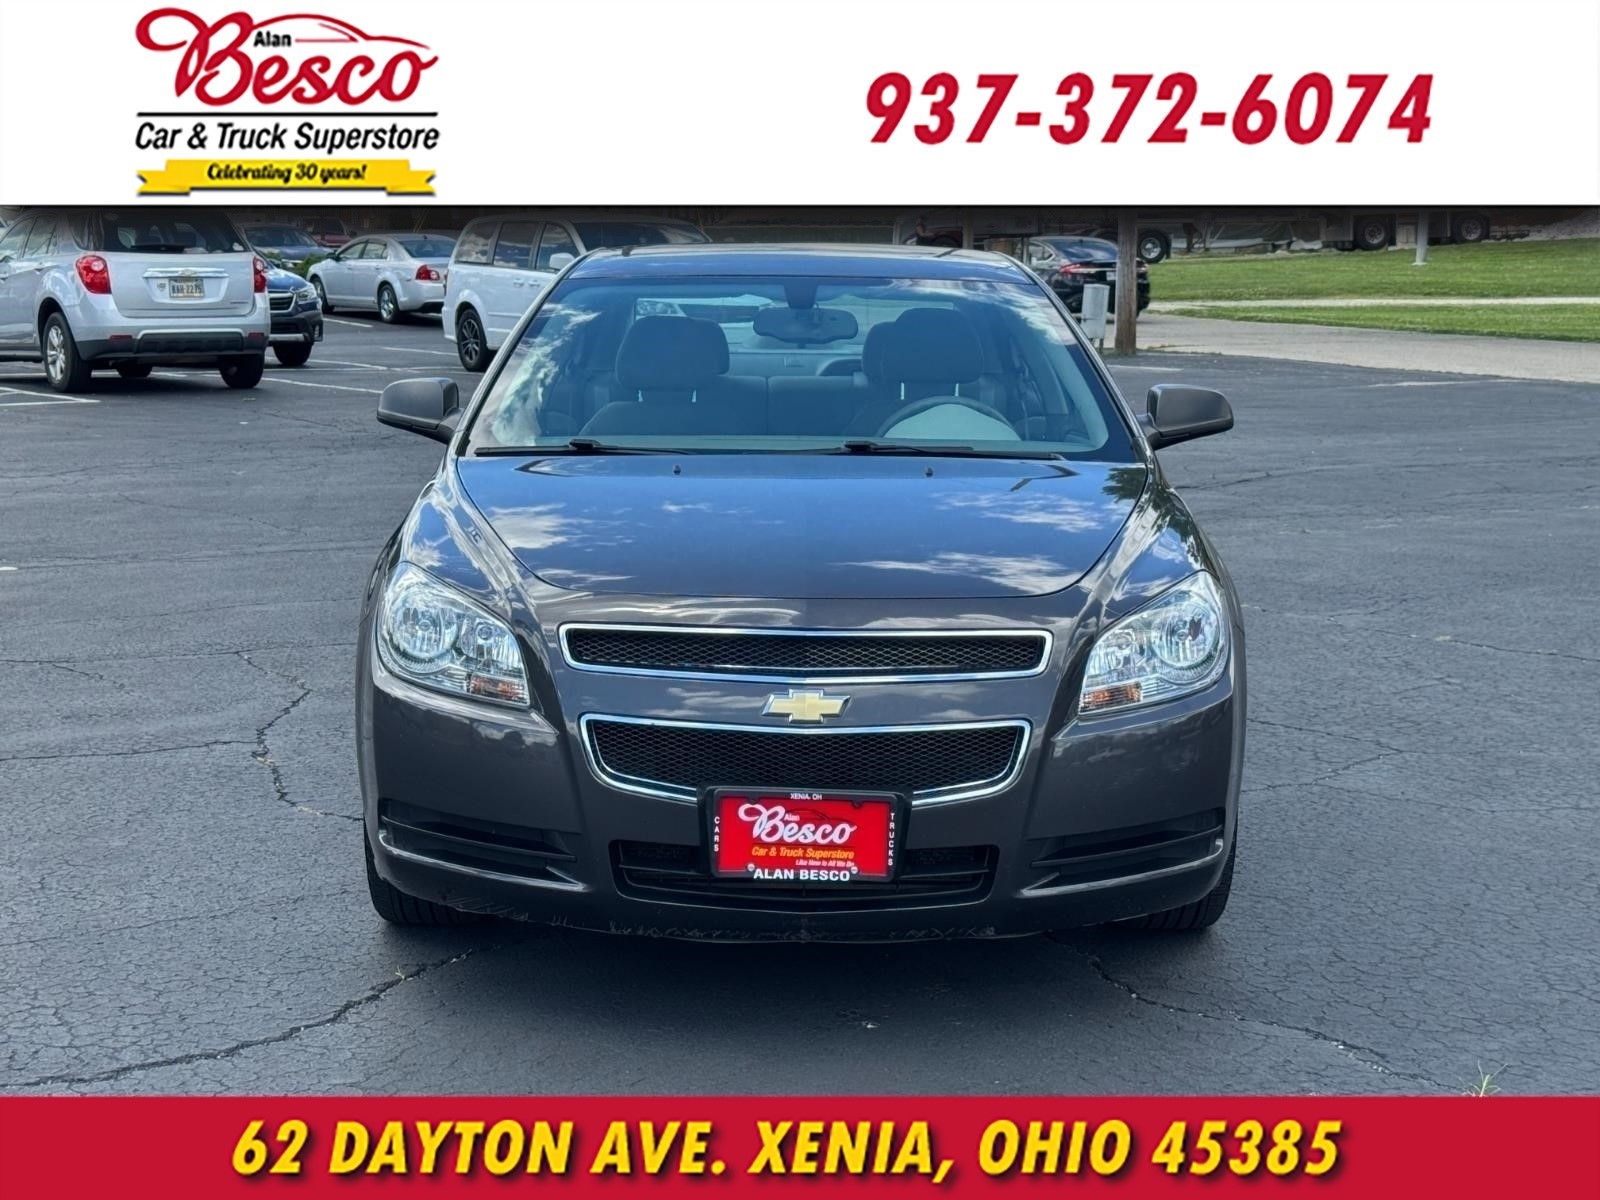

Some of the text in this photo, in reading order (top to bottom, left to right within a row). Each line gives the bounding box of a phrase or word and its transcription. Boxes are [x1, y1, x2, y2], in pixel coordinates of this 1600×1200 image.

[812, 793, 823, 801] OH
[784, 813, 800, 821] Alan
[738, 803, 857, 845] Besco
[751, 846, 855, 860] Car & Truck Superstore
[753, 868, 851, 881] ALAN BESCO
